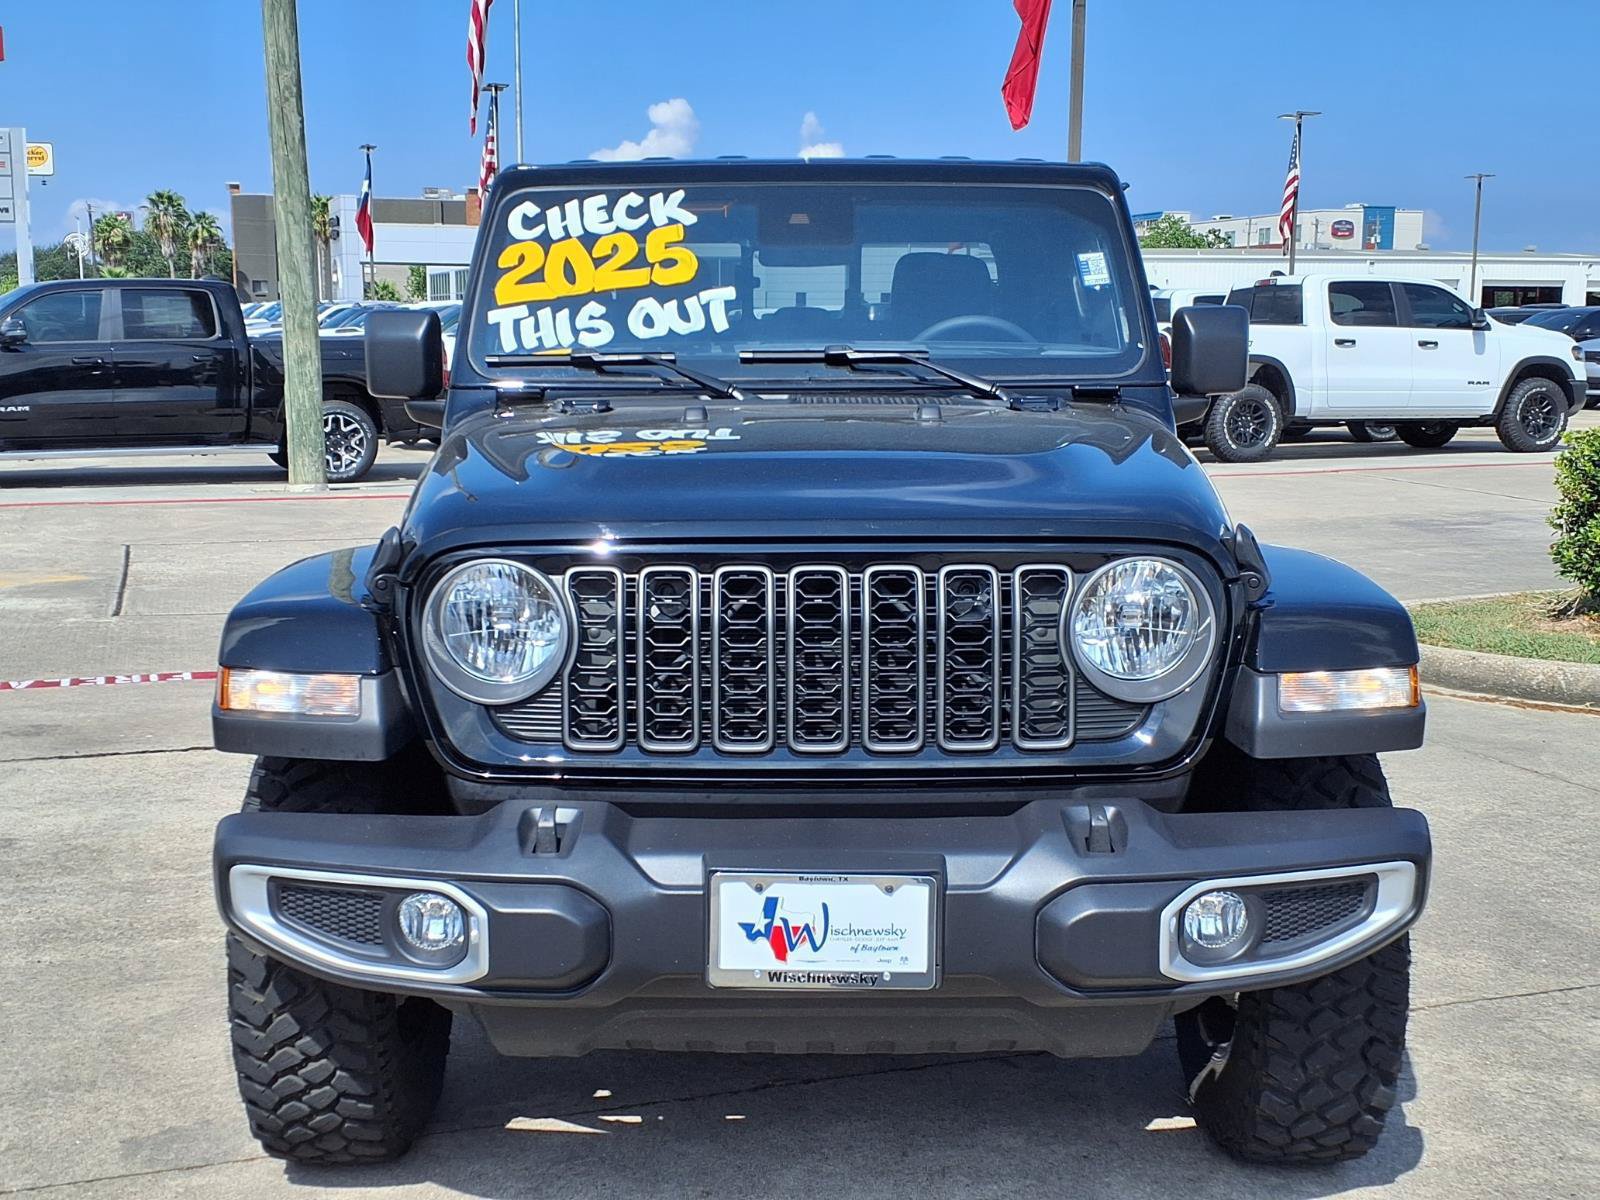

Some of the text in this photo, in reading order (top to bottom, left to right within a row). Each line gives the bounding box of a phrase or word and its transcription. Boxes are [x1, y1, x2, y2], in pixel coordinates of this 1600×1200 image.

[507, 189, 698, 241] CHECK
[494, 224, 699, 306] 2025
[487, 286, 736, 353] THIS OUT
[767, 971, 878, 987] Wischnewsky
